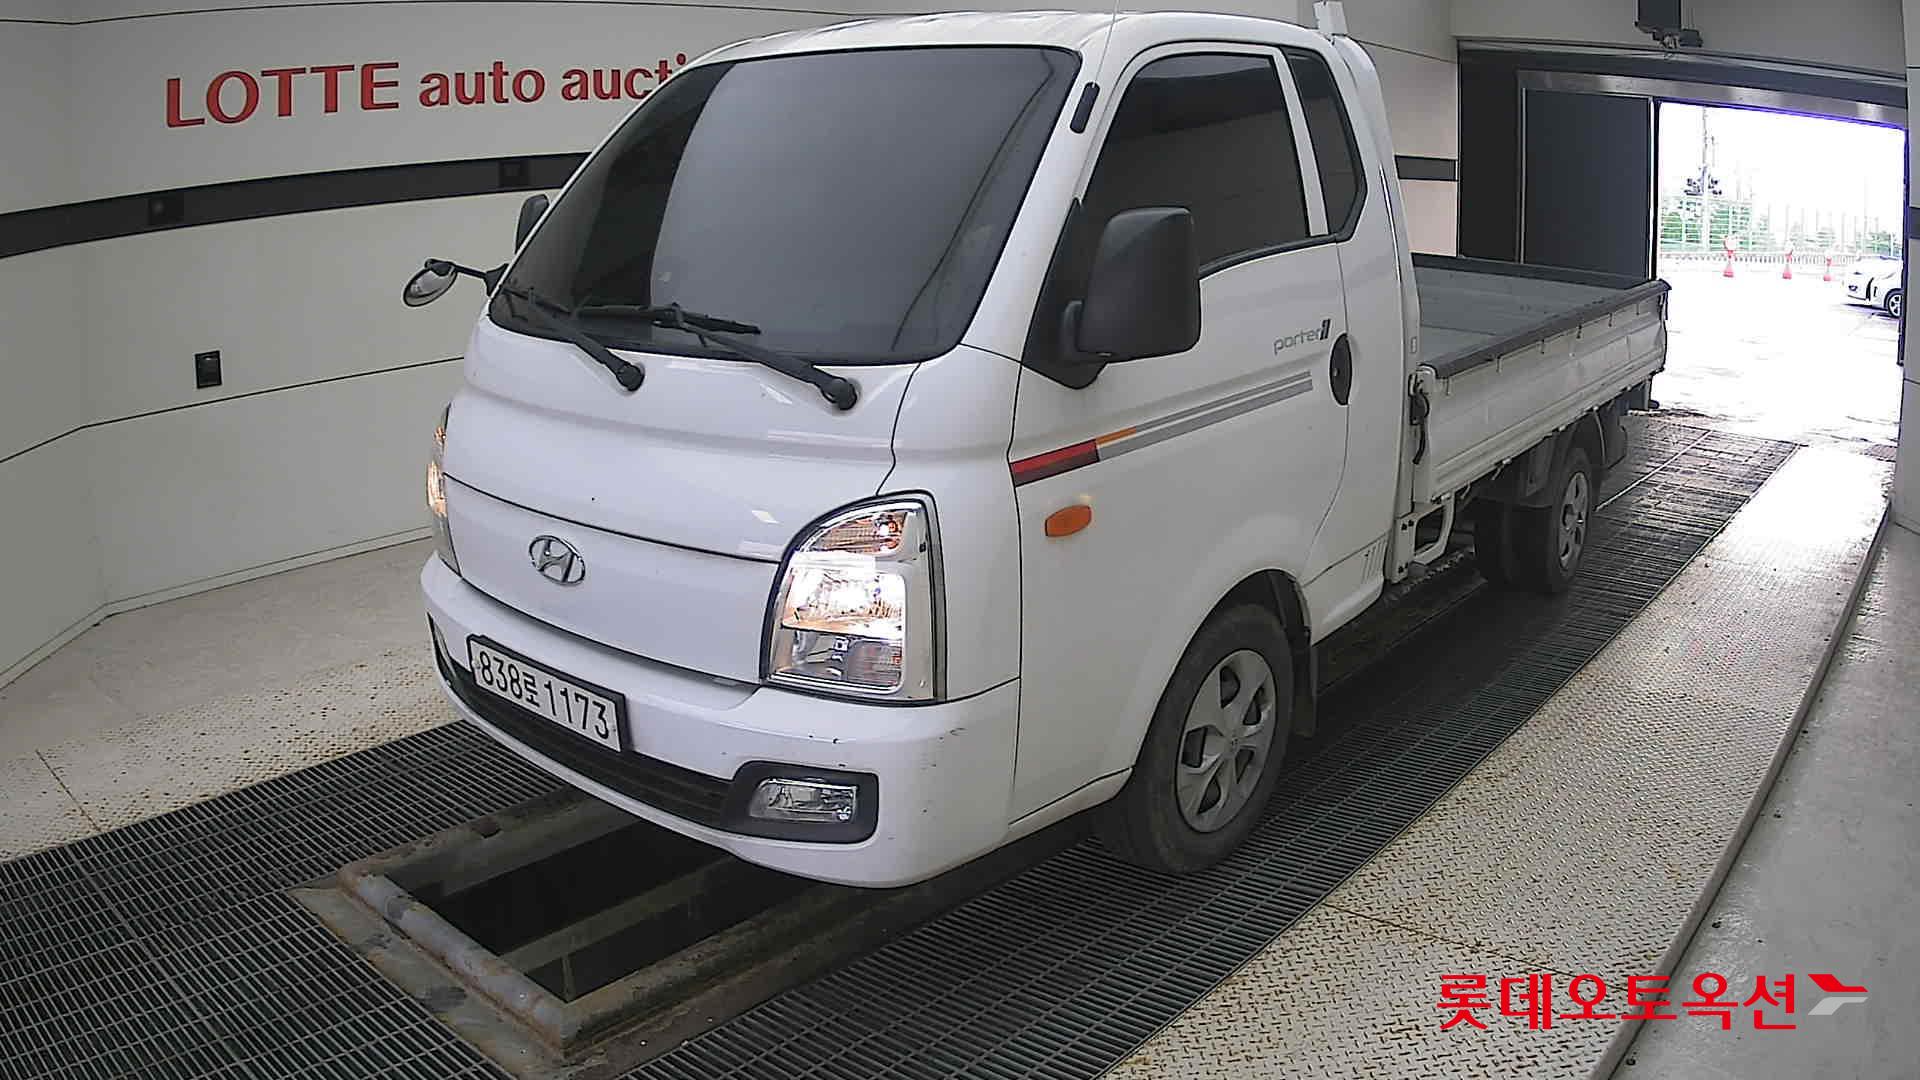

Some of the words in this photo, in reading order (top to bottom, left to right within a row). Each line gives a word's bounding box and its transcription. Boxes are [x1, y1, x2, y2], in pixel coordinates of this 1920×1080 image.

[166, 62, 400, 128] LOTTE
[418, 60, 545, 108] auto
[560, 53, 686, 101] auct
